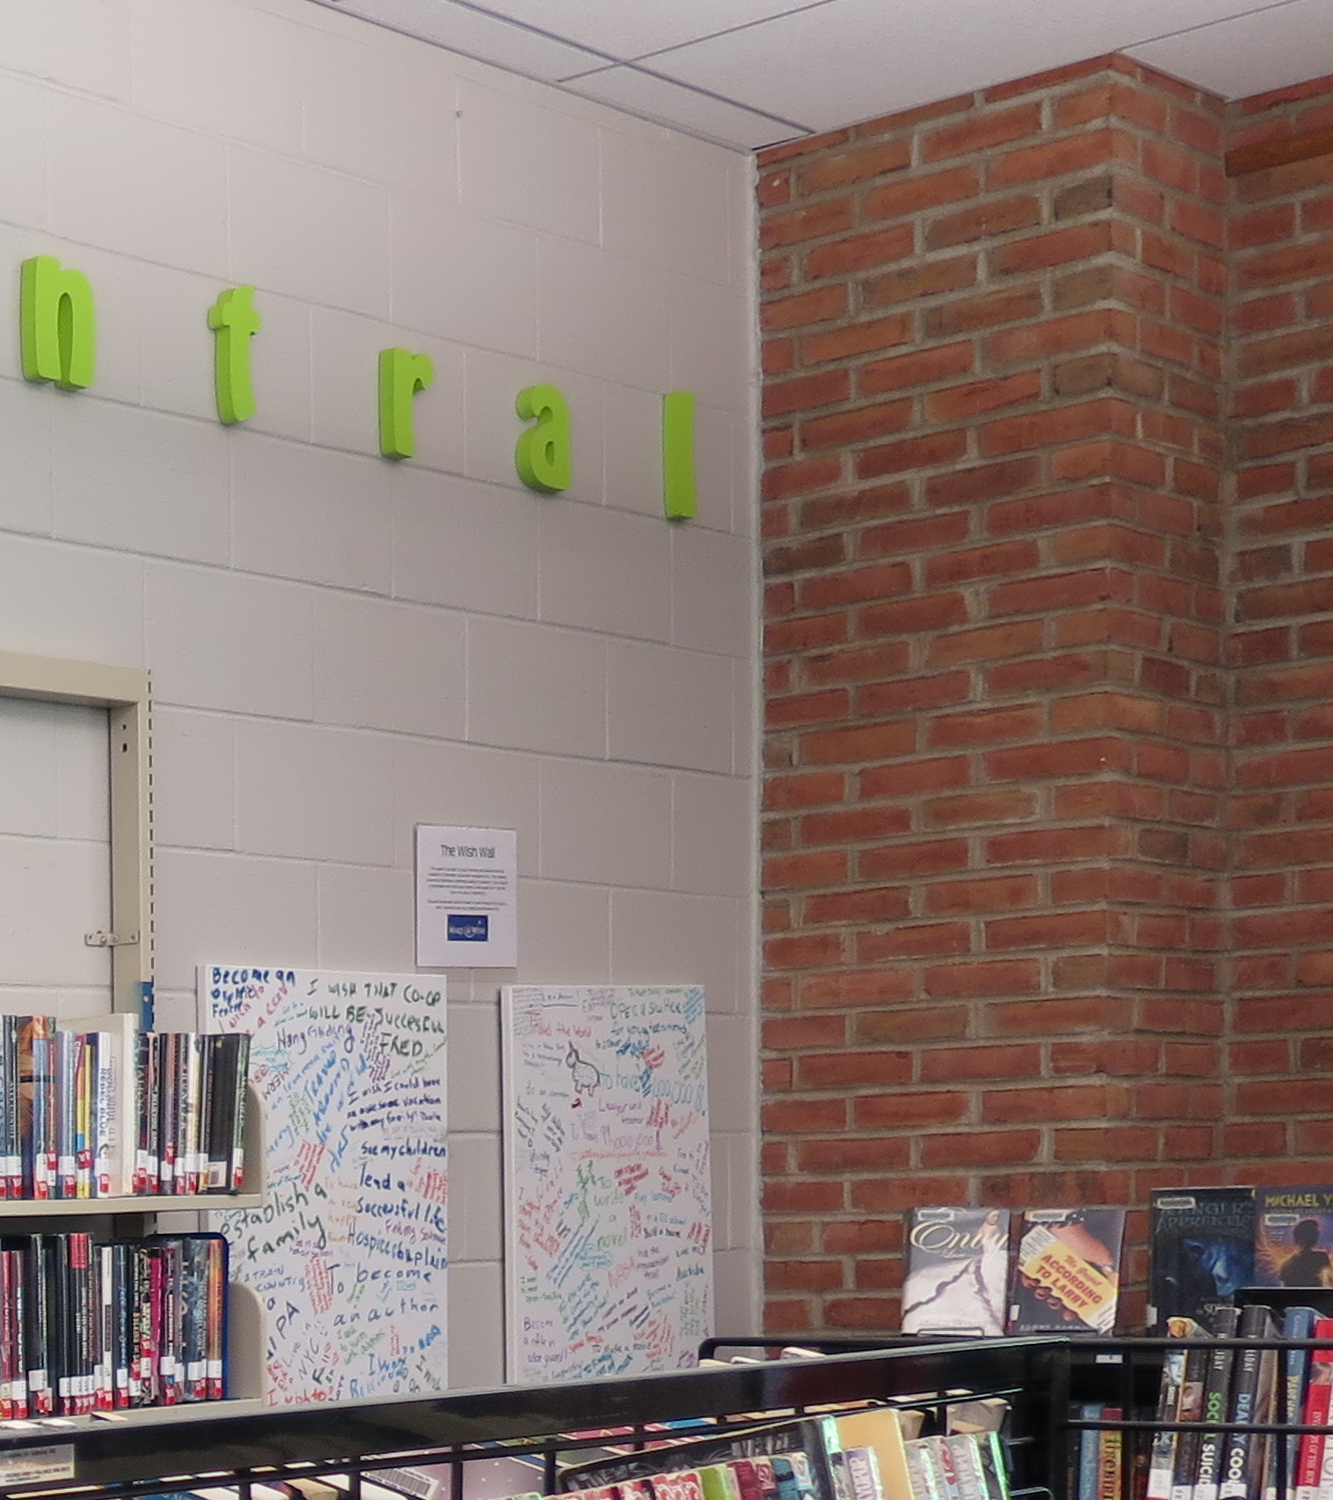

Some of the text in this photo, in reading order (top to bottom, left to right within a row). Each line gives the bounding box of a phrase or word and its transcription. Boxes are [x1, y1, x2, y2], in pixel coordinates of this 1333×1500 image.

[440, 844, 495, 859] The Wish Wall
[378, 1031, 423, 1057] FRED
[1265, 1193, 1319, 1208] MICHAEL
[1035, 1265, 1088, 1309] TO LARRY
[1040, 1253, 1103, 1306] ACCORDING
